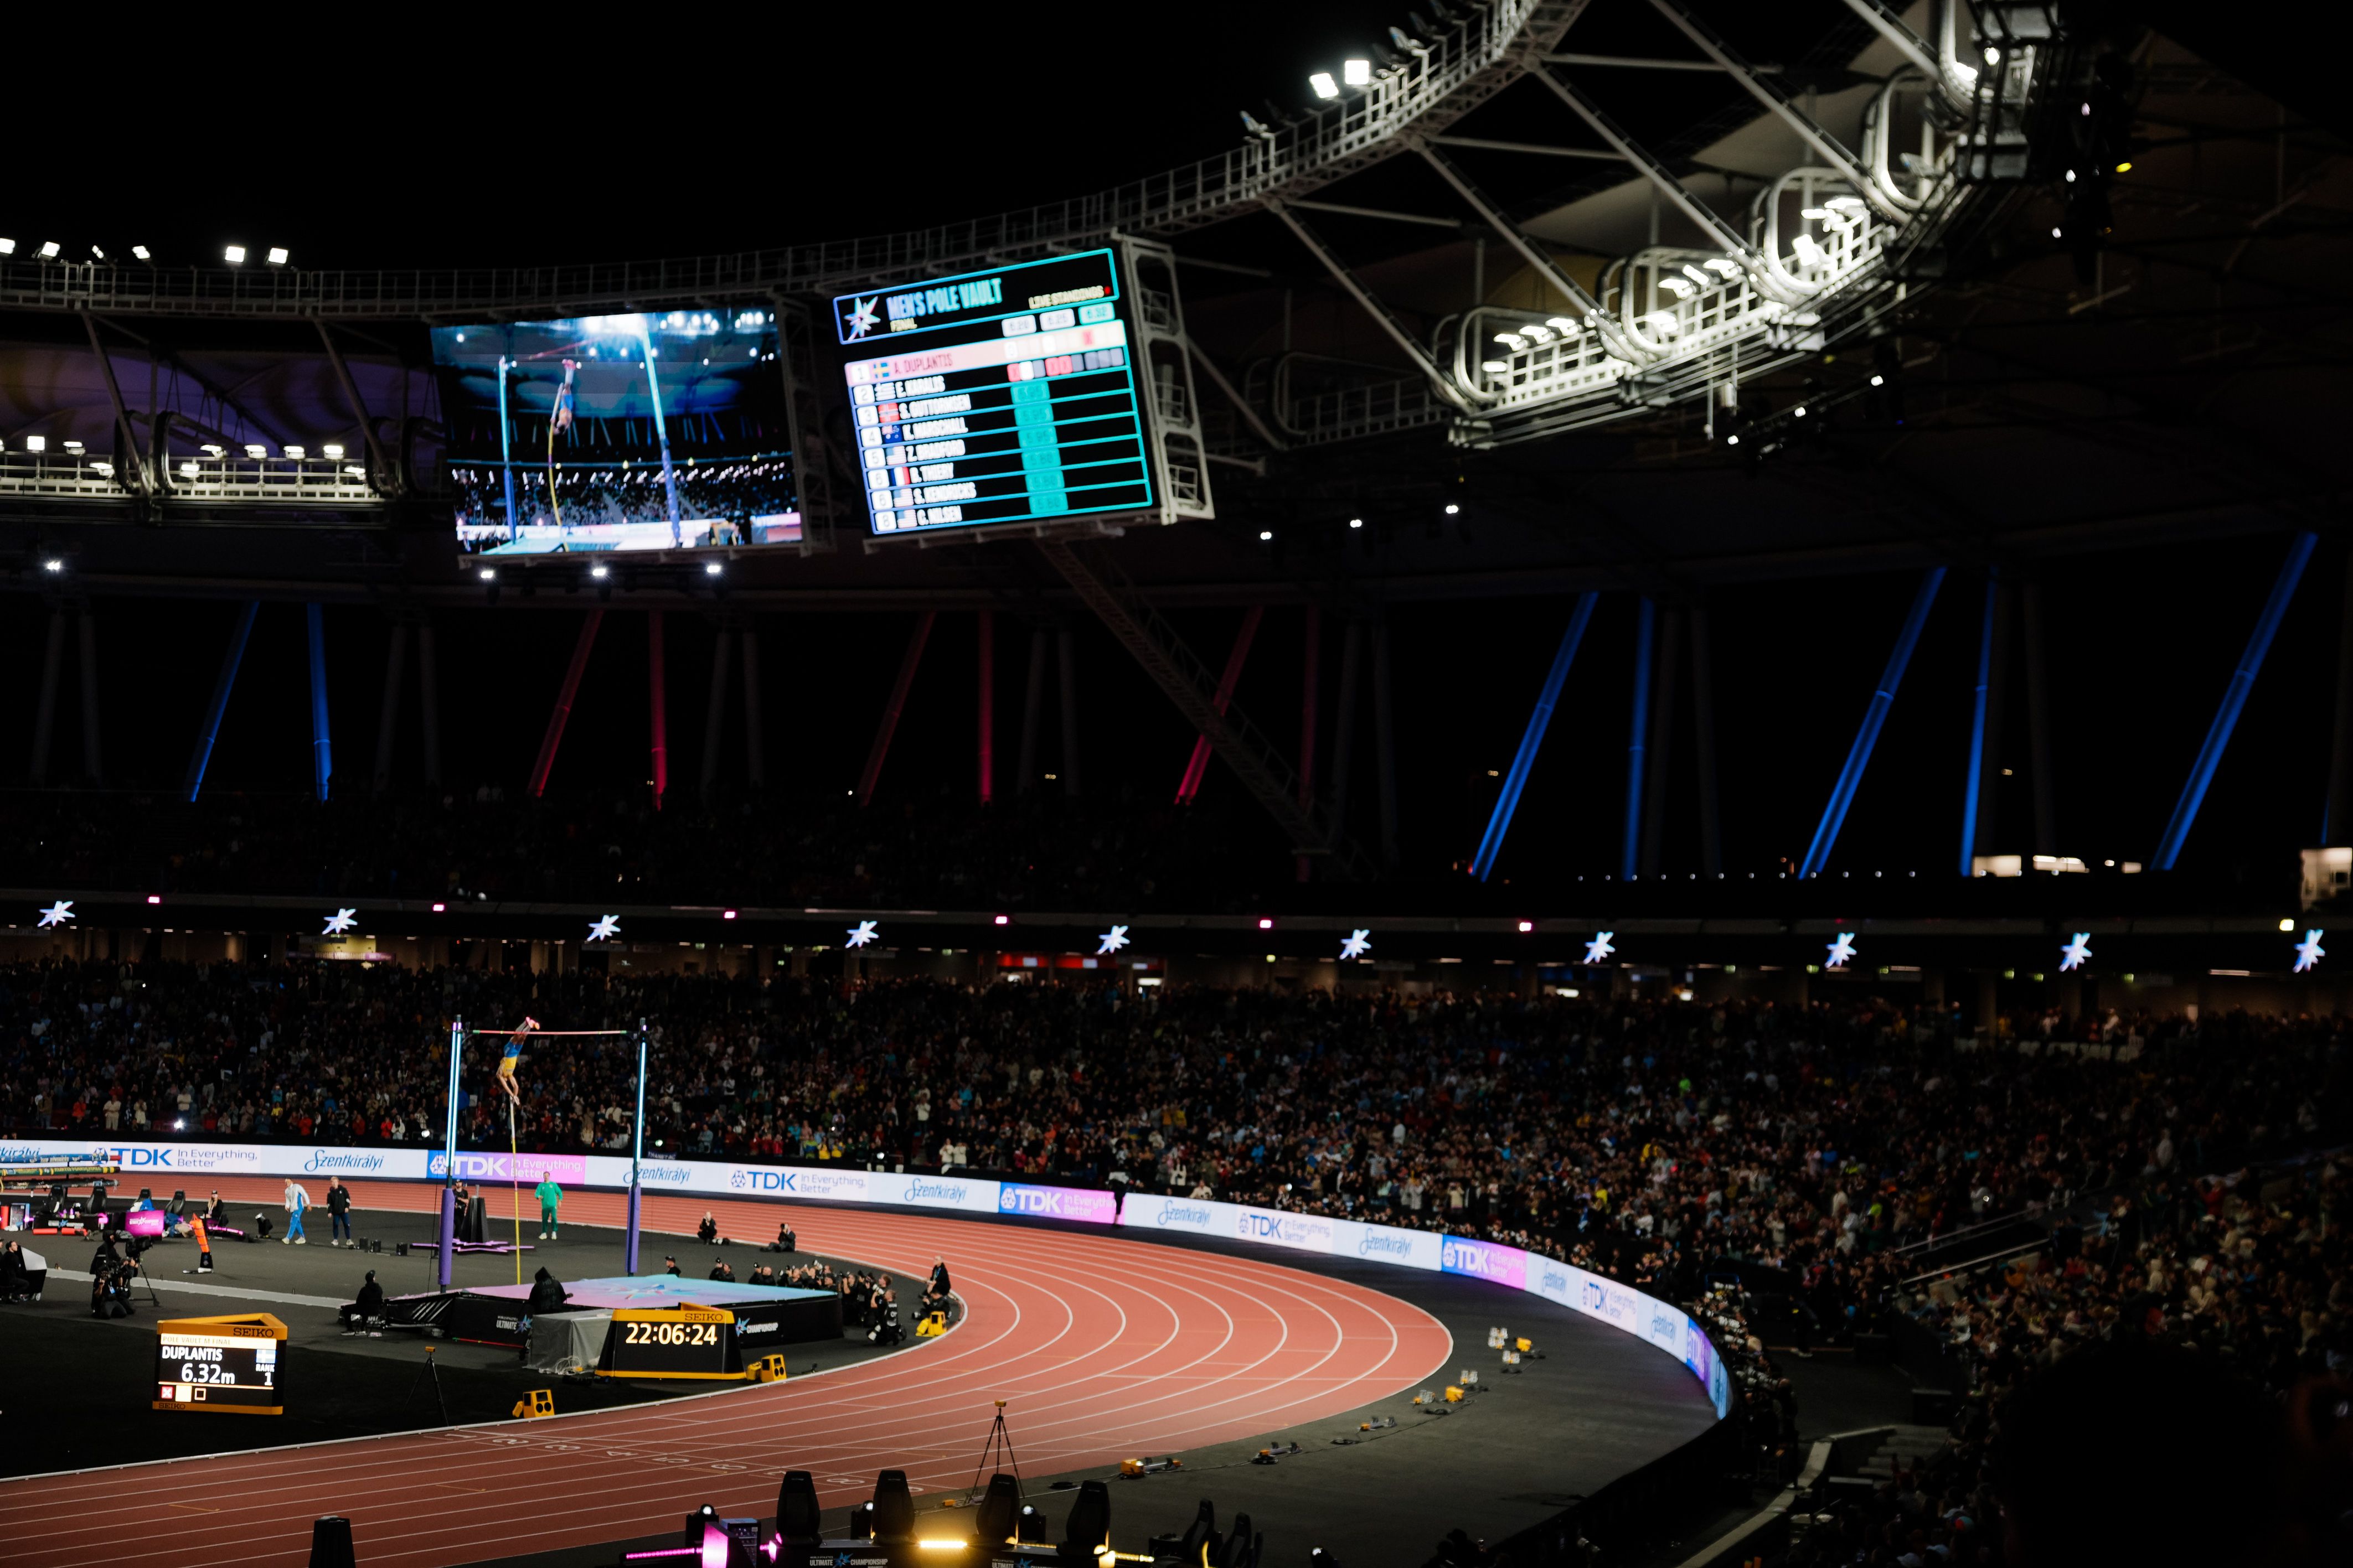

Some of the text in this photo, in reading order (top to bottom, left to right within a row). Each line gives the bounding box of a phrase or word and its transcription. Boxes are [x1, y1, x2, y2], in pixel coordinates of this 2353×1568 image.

[886, 278, 1002, 321] MEN'S POLE VAULT
[1028, 294, 1052, 309] LIVE
[905, 353, 953, 372] DUPLANTIS
[860, 388, 869, 401] 2
[895, 381, 907, 398] E.
[864, 410, 872, 422] 3
[869, 430, 875, 442] 4
[871, 452, 879, 464] 5
[905, 446, 917, 462] Z.
[876, 472, 883, 485] 6
[879, 494, 886, 506] 6
[913, 488, 925, 504] S.
[883, 515, 890, 527] 8
[110, 1148, 173, 1166] TDK
[177, 1158, 215, 1167] Better
[178, 1149, 257, 1161] In Everything,
[305, 1149, 384, 1172] Szentkirályi
[452, 1156, 508, 1177] TDK
[510, 1157, 582, 1172] In Everything,
[747, 1171, 797, 1192] TDK
[801, 1174, 866, 1188] In Everything,
[801, 1184, 831, 1193] Better
[905, 1178, 967, 1204] Szentkirályi
[1064, 1194, 1072, 1203] In
[1015, 1189, 1062, 1214] TDK
[1064, 1205, 1093, 1218] Better
[1158, 1200, 1211, 1228] Szentkirályi
[1250, 1214, 1282, 1239] TDK
[1285, 1219, 1332, 1236] In Everything,
[1284, 1231, 1306, 1242] Better
[1359, 1228, 1412, 1259] Szentkirályi
[1454, 1243, 1491, 1274] TDK
[1589, 1282, 1608, 1315] TDK
[496, 1320, 518, 1331] ULTIMATE
[685, 1313, 723, 1322] SEIKO
[233, 1327, 274, 1337] SEIKO
[625, 1322, 718, 1346] 22:06:24
[747, 1322, 778, 1334] CHAMPIONSHIP
[162, 1346, 223, 1362] DUPLANTIS
[181, 1363, 235, 1385] 6.32m
[255, 1364, 275, 1373] RANK
[264, 1372, 272, 1386] 1
